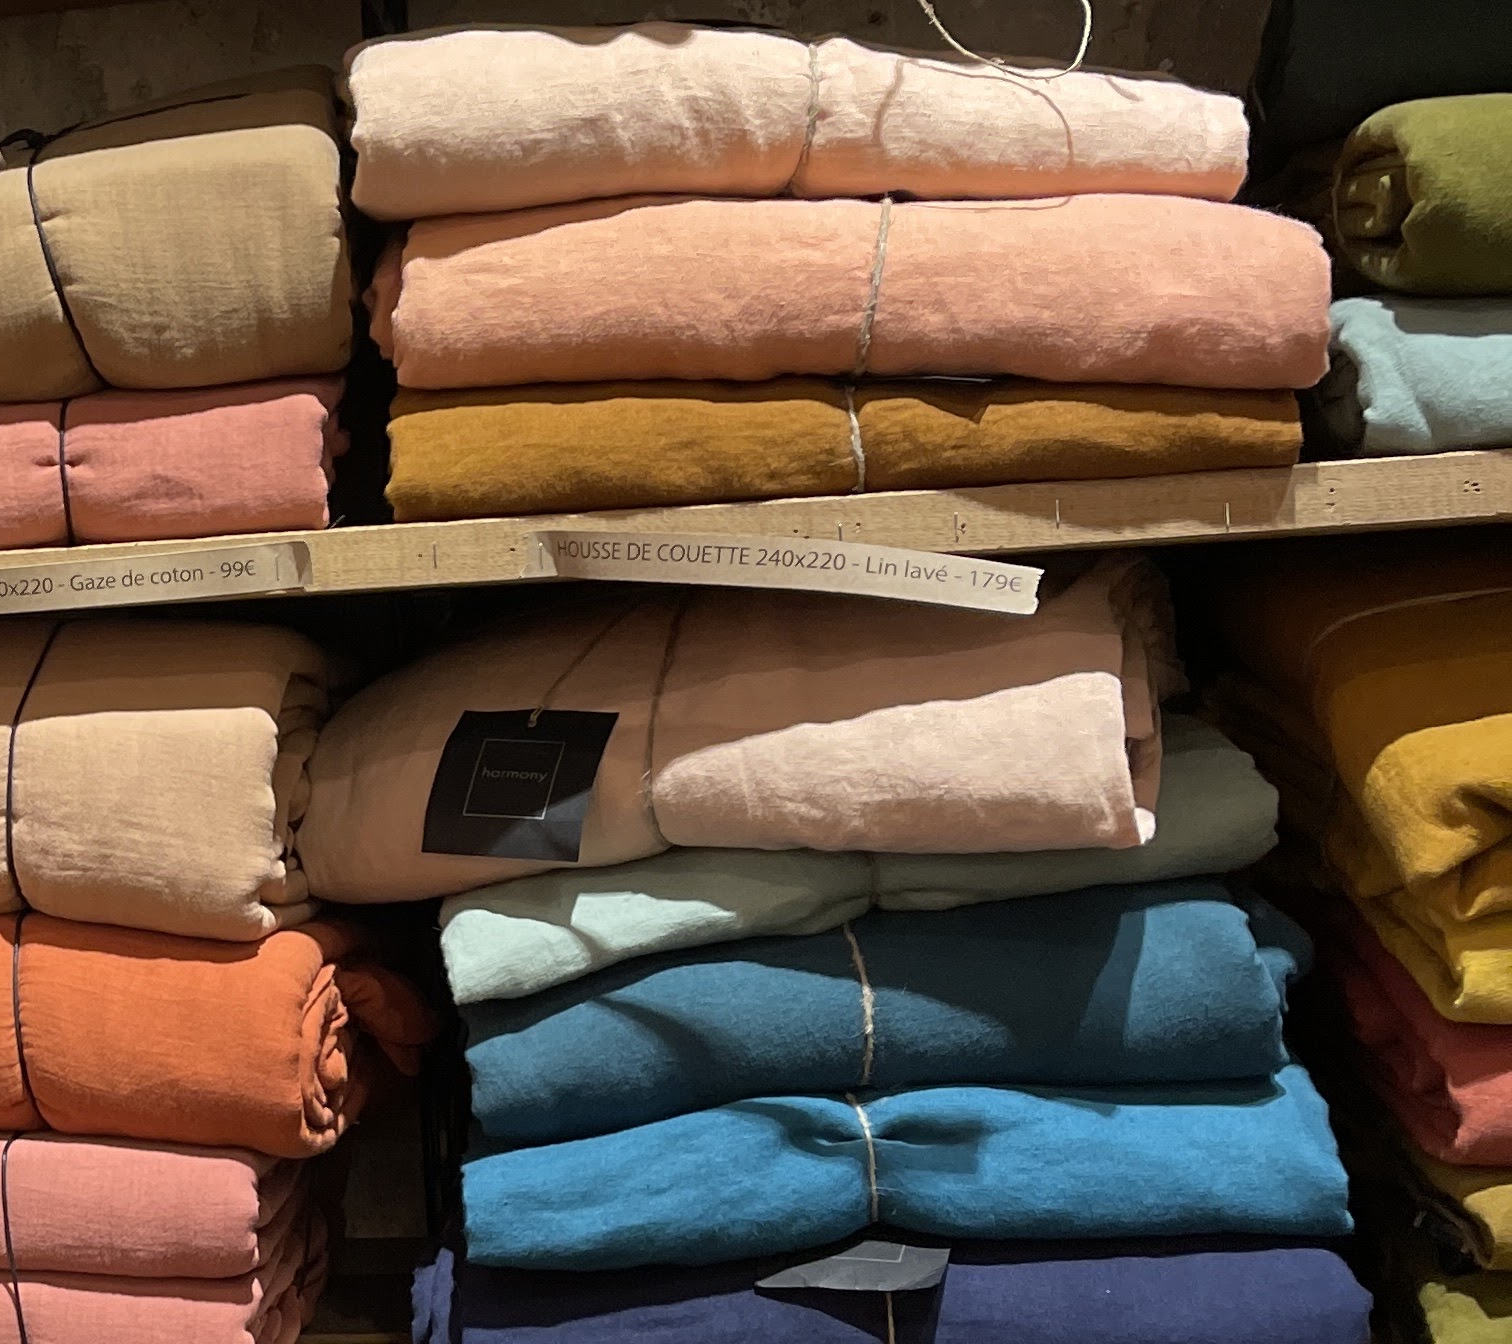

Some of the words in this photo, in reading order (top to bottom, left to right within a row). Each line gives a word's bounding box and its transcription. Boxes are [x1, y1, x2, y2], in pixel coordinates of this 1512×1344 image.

[70, 574, 117, 592] Gaze
[121, 569, 145, 588] de
[148, 567, 203, 585] coton
[220, 559, 256, 579] 99€
[557, 540, 620, 561] HOUSSE
[627, 542, 651, 562] DE
[657, 543, 750, 566] COUETTE
[756, 548, 846, 571] 240x220
[866, 556, 897, 577] Lin
[904, 559, 948, 583] lavé
[971, 570, 1022, 593] 179€
[481, 766, 548, 783] harmony
